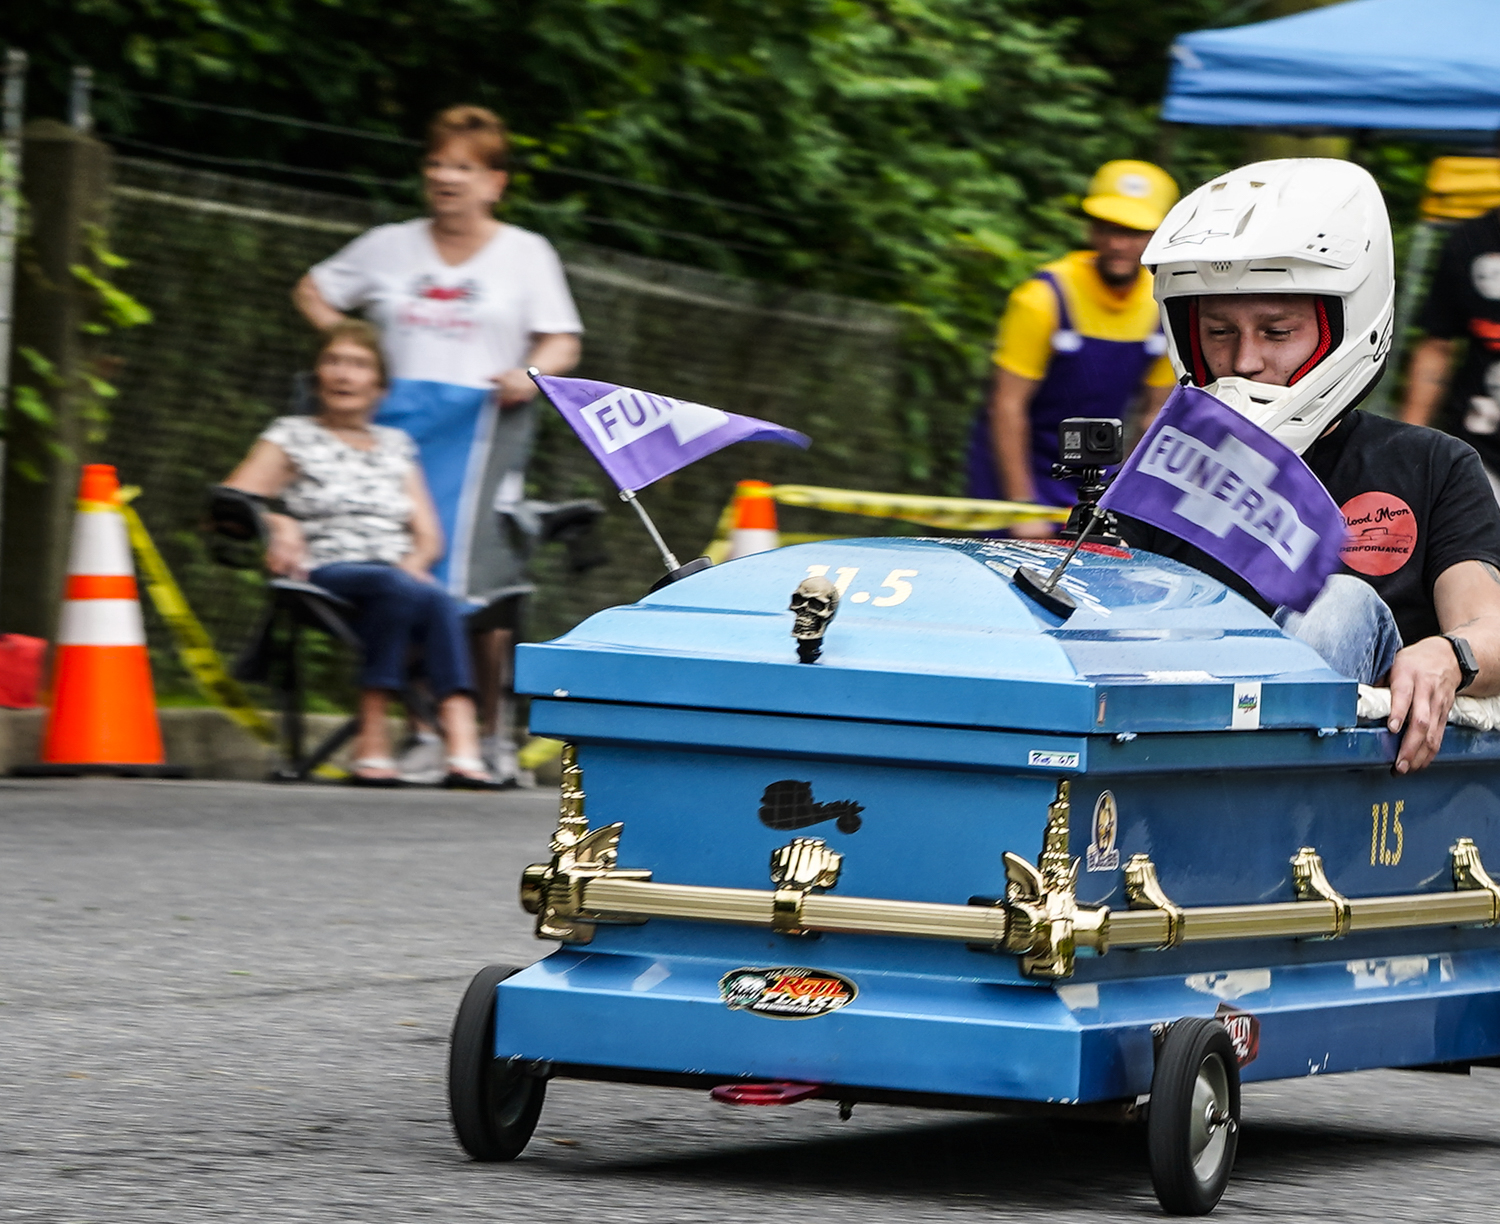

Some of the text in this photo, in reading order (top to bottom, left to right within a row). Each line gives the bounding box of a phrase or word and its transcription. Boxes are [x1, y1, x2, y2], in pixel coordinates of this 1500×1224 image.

[595, 393, 687, 441] FUN
[1147, 434, 1298, 556] FUNERAL
[1375, 507, 1410, 523] Moon
[1340, 545, 1409, 554] PERFORMANCE
[1370, 800, 1405, 867] 11.5
